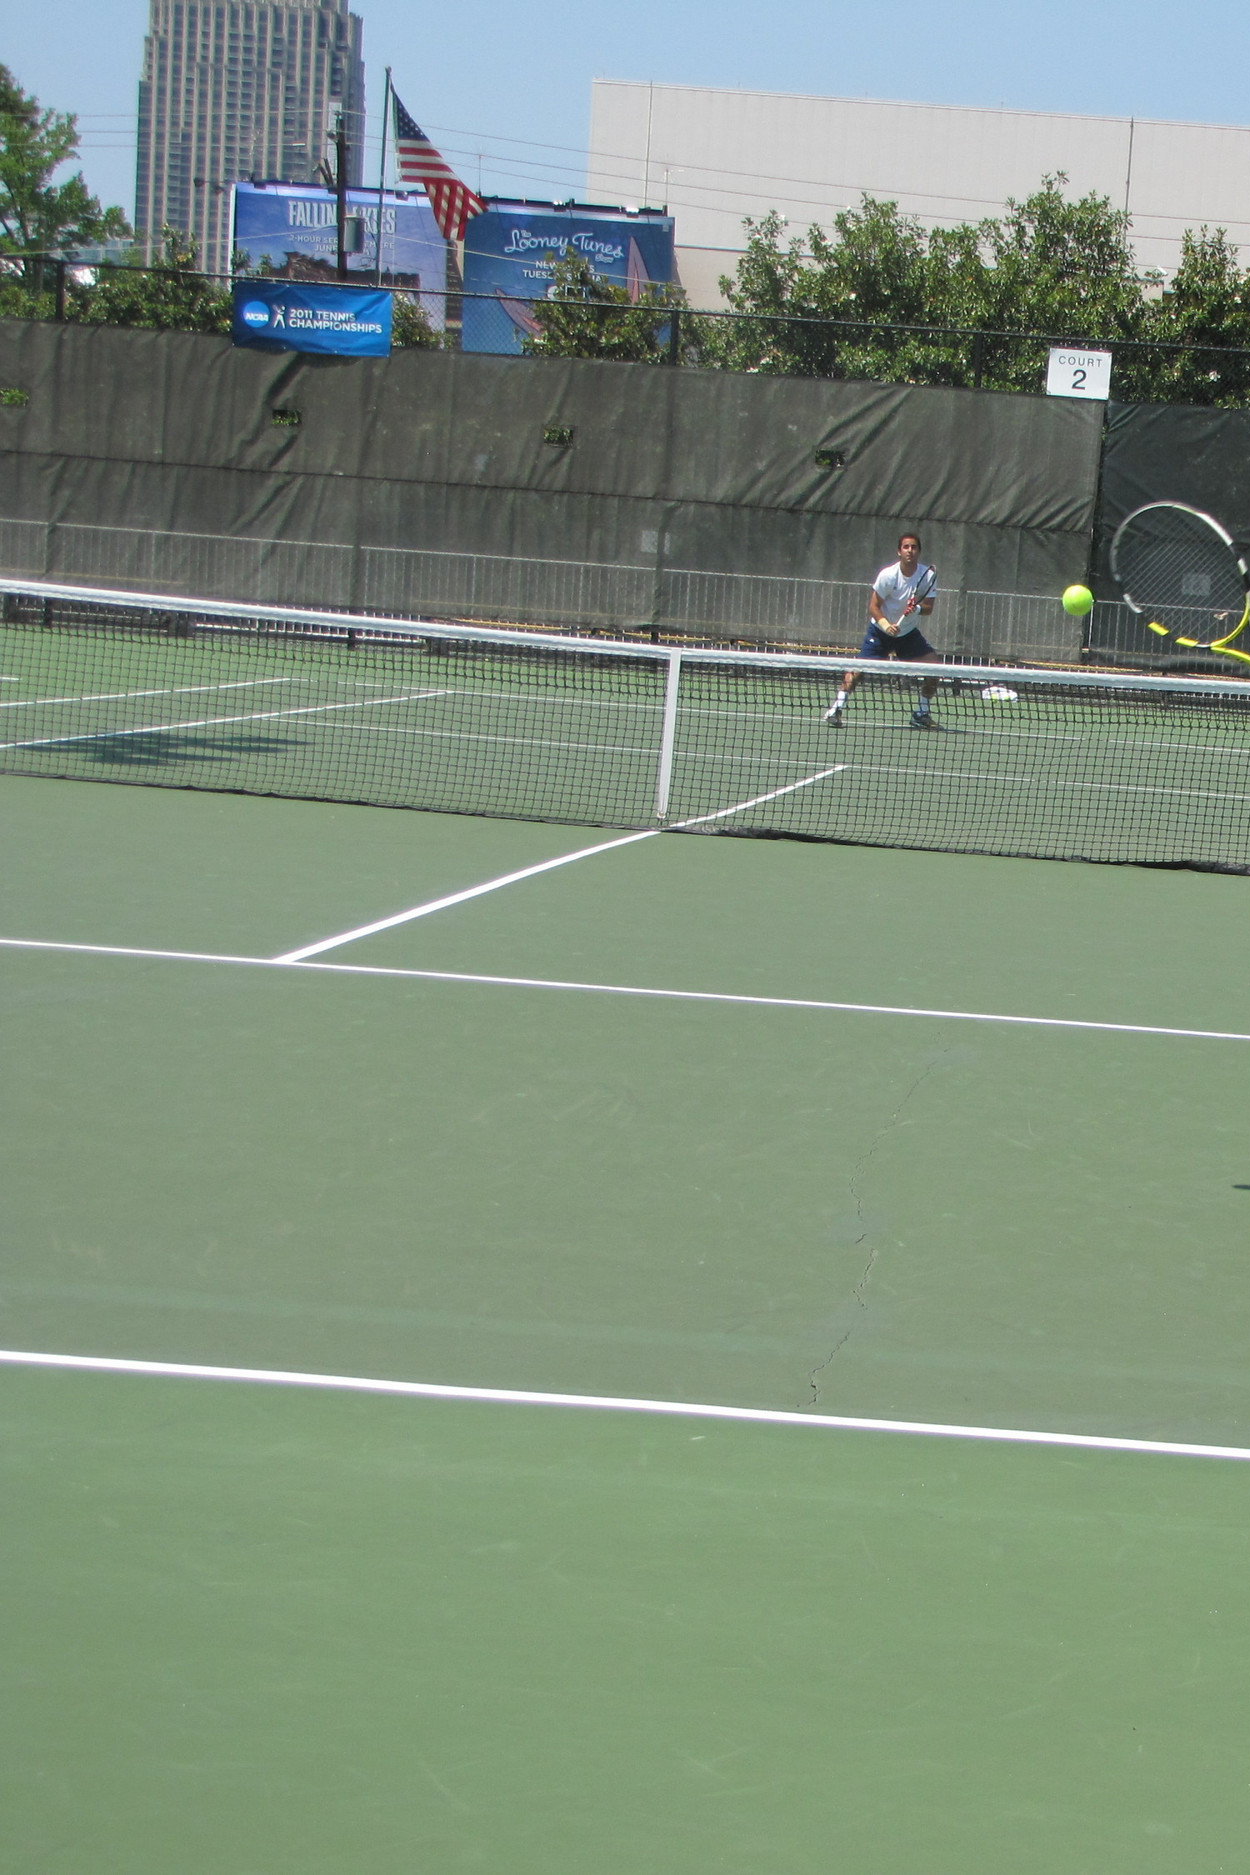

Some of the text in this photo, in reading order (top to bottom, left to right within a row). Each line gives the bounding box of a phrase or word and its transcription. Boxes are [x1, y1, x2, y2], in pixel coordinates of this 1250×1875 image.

[288, 201, 338, 228] FALLIN
[504, 229, 624, 257] Looney Tunes
[244, 312, 269, 321] NCAA
[290, 308, 356, 321] 2011 TENNIS
[289, 319, 383, 334] CHAMPIONSHIPS
[1058, 356, 1103, 367] COURT
[1071, 369, 1087, 390] 2
